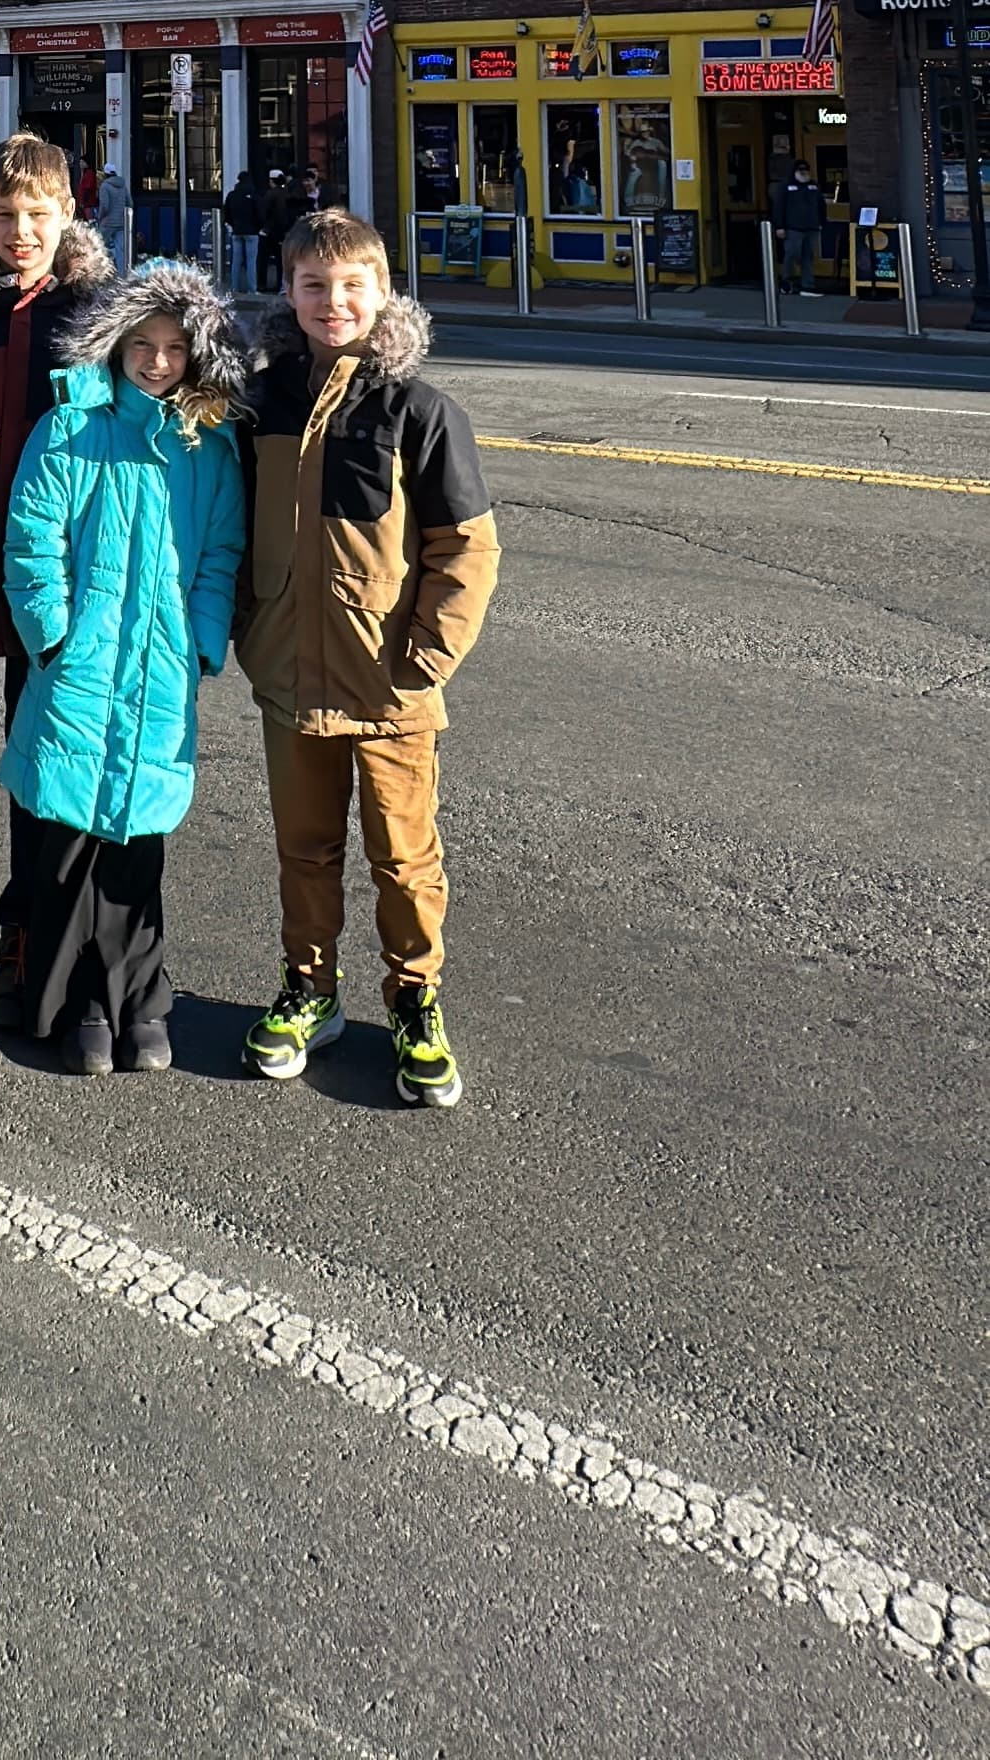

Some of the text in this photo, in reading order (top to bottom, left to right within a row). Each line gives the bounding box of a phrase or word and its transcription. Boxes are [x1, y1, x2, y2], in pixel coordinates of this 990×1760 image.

[290, 29, 319, 37] FLOOR
[37, 38, 77, 47] CHRISTMAS
[480, 51, 507, 59] Real
[52, 63, 77, 71] HANK
[471, 58, 517, 69] Country
[703, 61, 834, 75] IT'S FIVE O'CLOCK
[37, 72, 81, 83] WILLIAMS
[476, 69, 513, 77] Music
[705, 73, 835, 91] SOMEWHERE
[51, 101, 72, 112] 419
[819, 108, 847, 124] Karao
